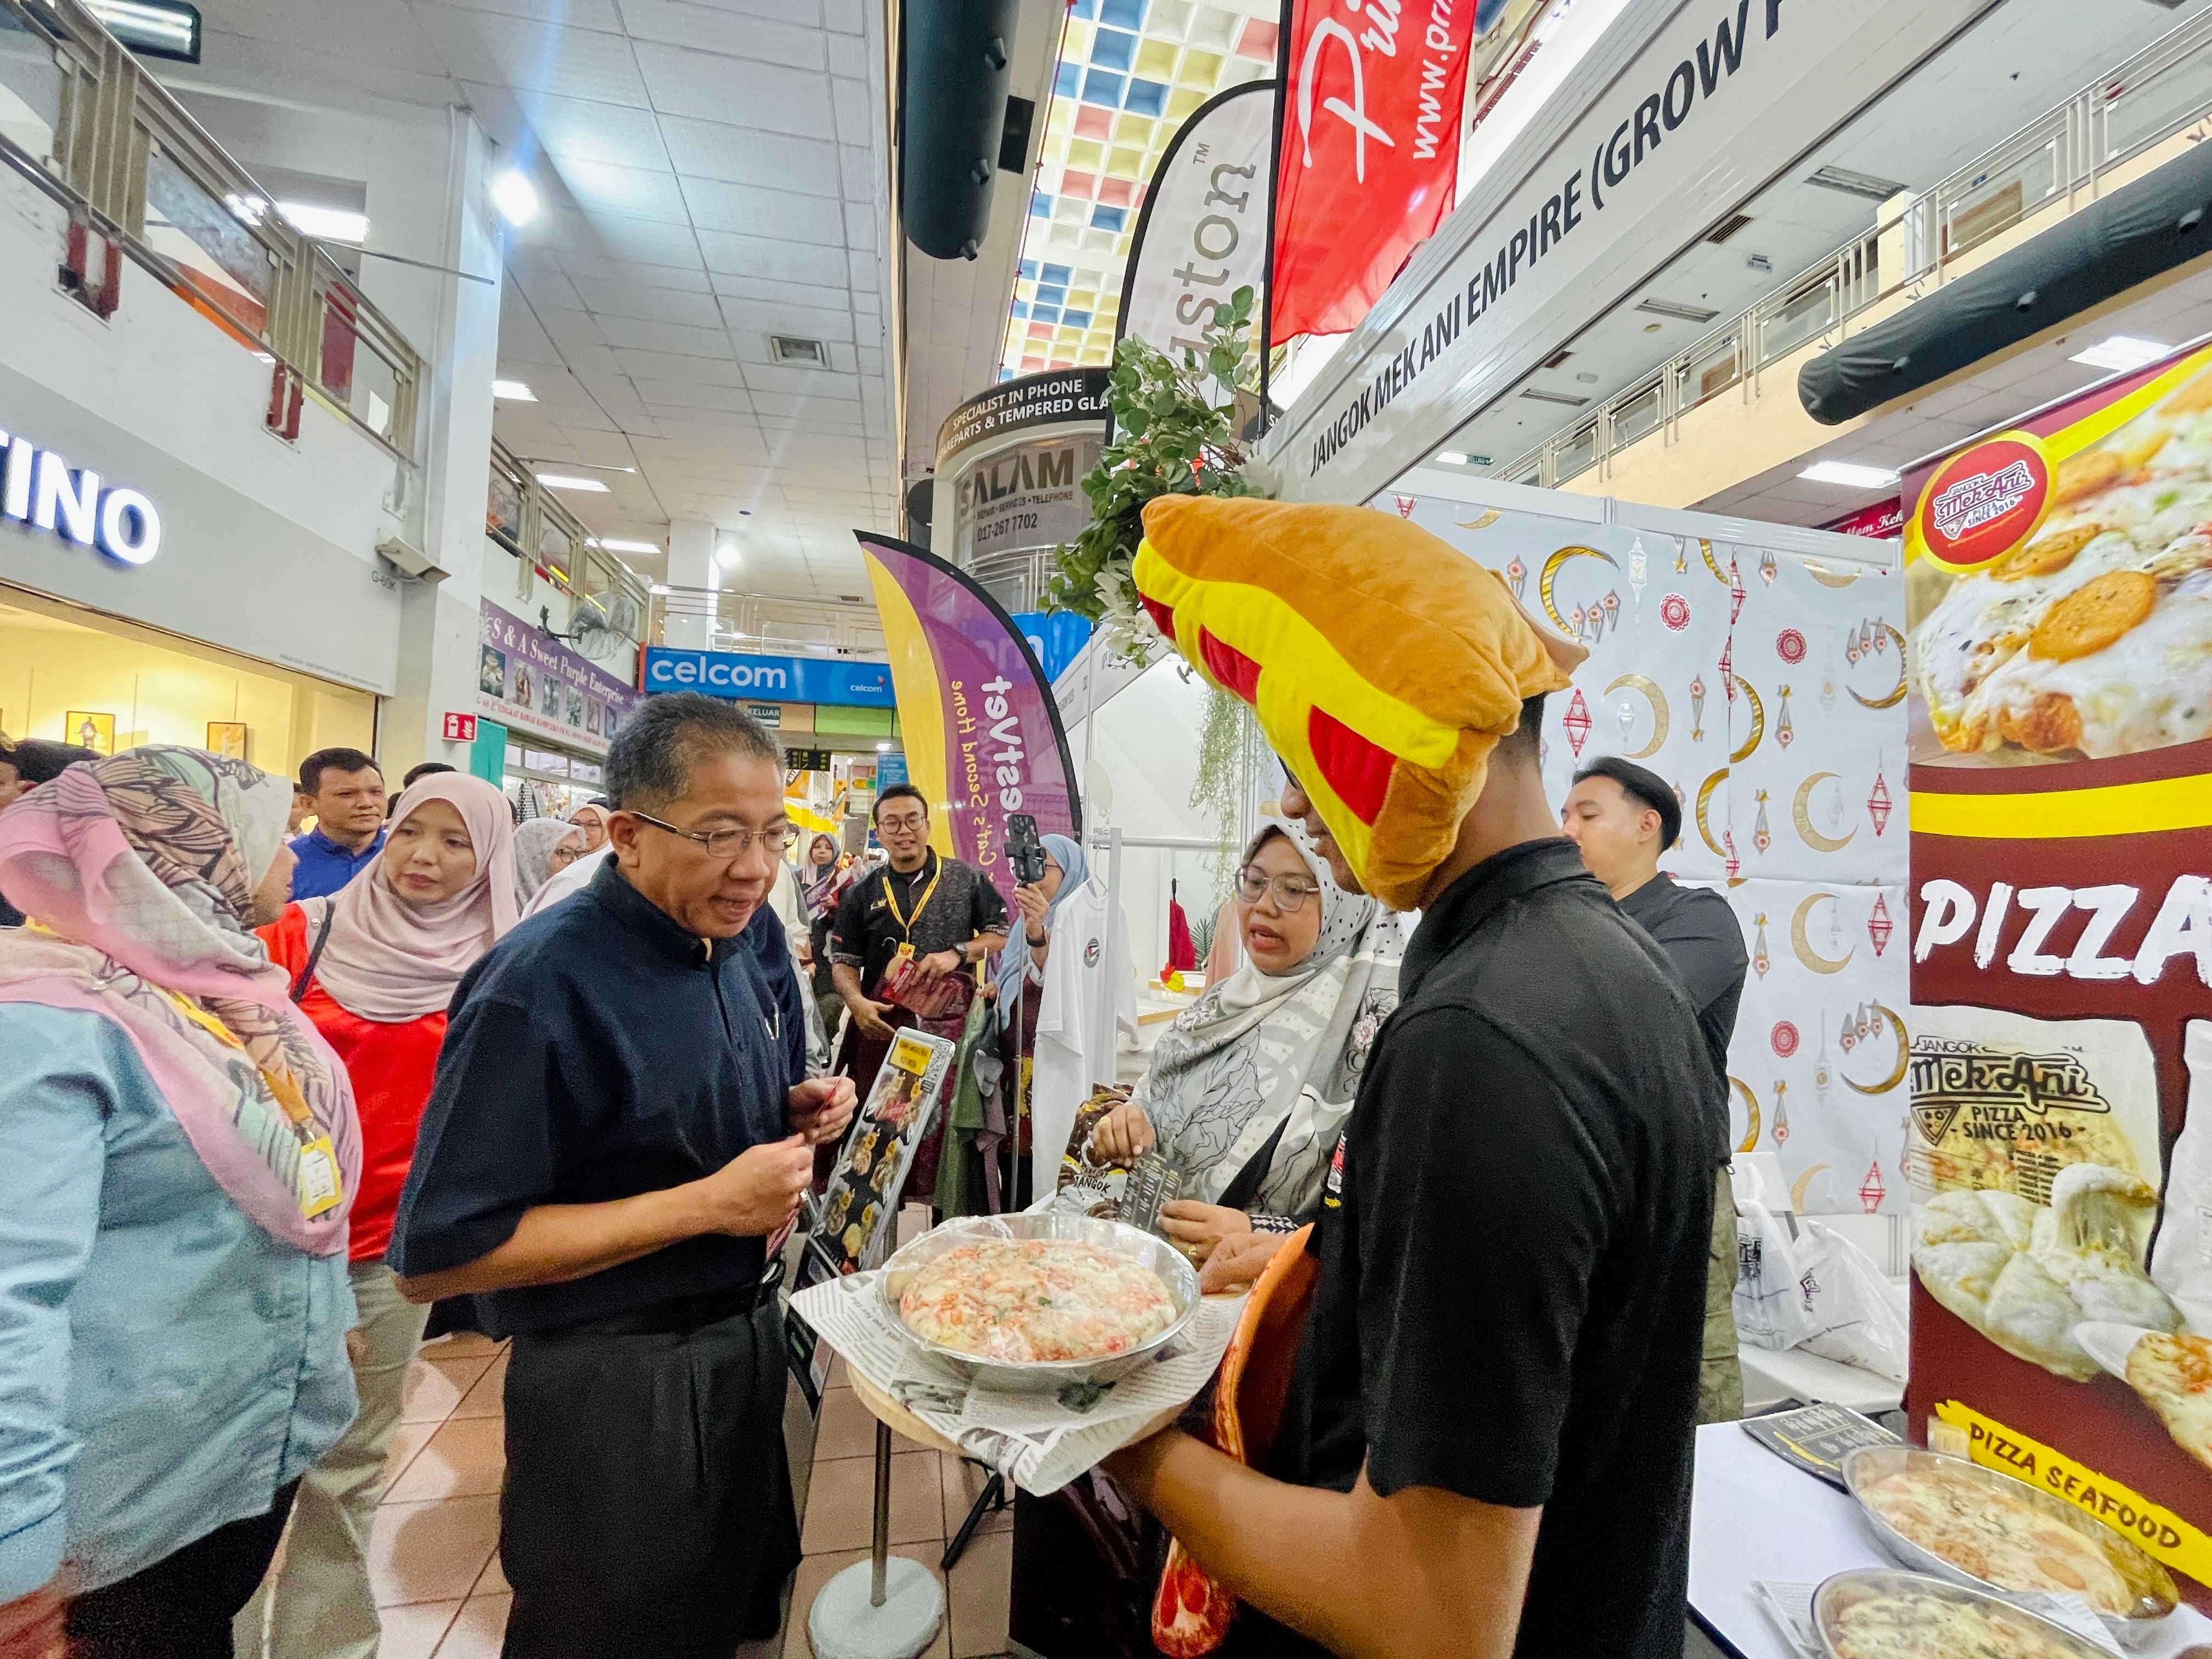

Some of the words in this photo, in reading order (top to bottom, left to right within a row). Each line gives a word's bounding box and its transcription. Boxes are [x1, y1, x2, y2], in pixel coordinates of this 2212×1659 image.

[1311, 385, 1372, 477] JANGOK
[1374, 338, 1417, 416] MEK
[1420, 294, 1460, 372] ANI
[1468, 168, 1582, 326] EMPIRE
[952, 394, 1006, 431] SPECIALIST
[1008, 388, 1023, 405] IN
[1028, 379, 1082, 400] PHONE
[984, 415, 995, 430] &
[998, 399, 1073, 426] TEMPERED
[0, 429, 161, 564] INO
[1032, 490, 1074, 505] TELEPHONE
[492, 617, 502, 639] S
[504, 625, 516, 647] &
[517, 633, 527, 654] A
[530, 639, 557, 670] Sweet
[560, 655, 588, 687] Purple
[589, 672, 624, 706] Enterprise
[651, 656, 786, 689] celcom
[850, 685, 882, 693] celcom
[1915, 874, 2212, 986] PIZZA
[1920, 1039, 1982, 1054] JANGOK
[1971, 1106, 2027, 1122] PIZZA
[1963, 1122, 2017, 1141] SINCE
[2022, 1123, 2073, 1141] 2016
[1970, 1422, 2037, 1476] PIZZA
[2046, 1465, 2182, 1549] SEAFOOD
